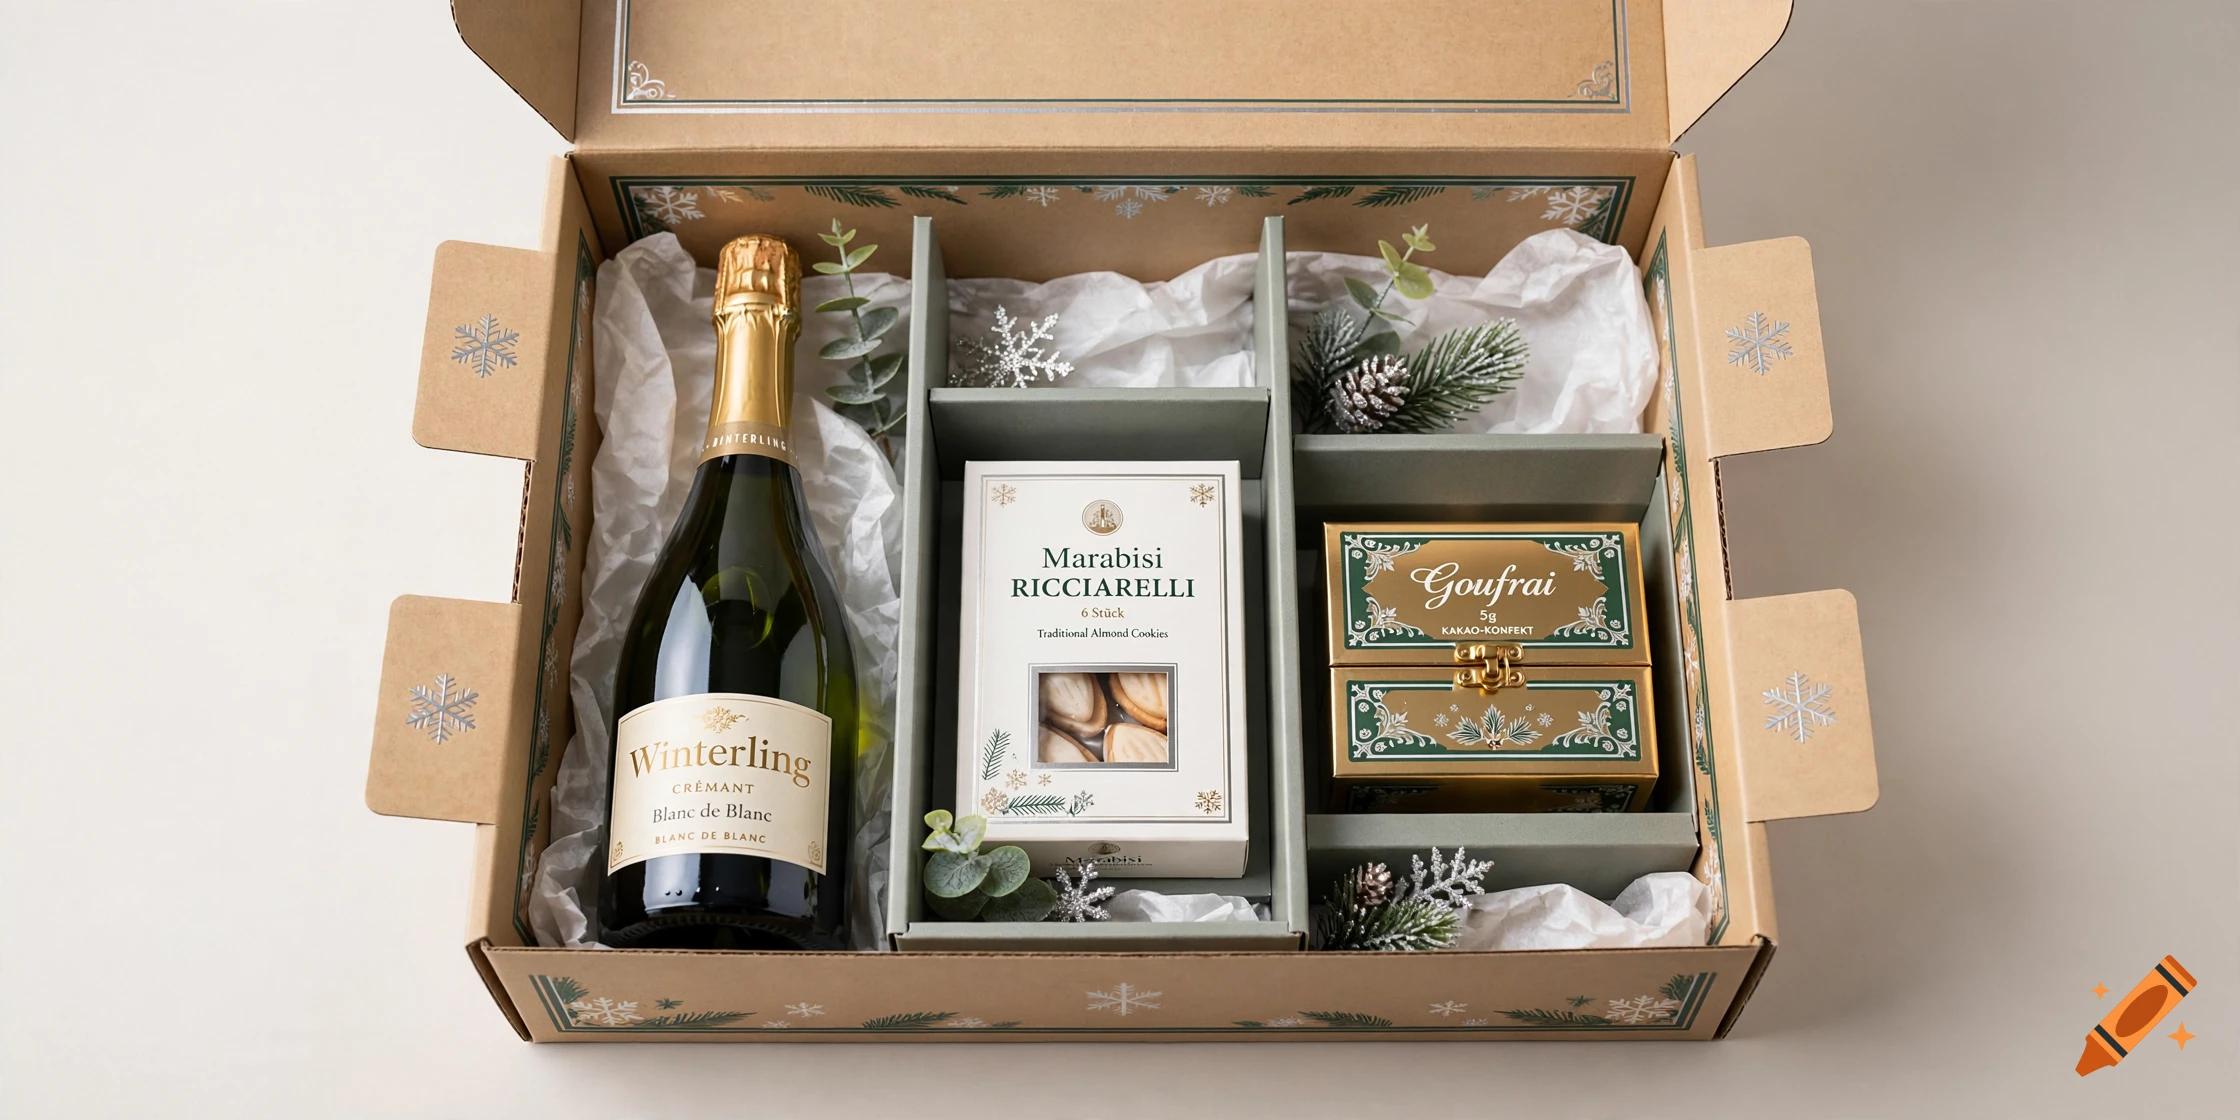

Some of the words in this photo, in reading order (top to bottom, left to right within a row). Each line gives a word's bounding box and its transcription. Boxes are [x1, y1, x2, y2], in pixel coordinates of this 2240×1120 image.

[1042, 547, 1164, 569] Marabisi
[1010, 577, 1196, 598] RICCIARELLI
[1409, 561, 1557, 610] Goufrai
[1081, 607, 1089, 618] 6
[1091, 606, 1125, 618] Stück
[1479, 609, 1497, 624] 5g
[1036, 627, 1088, 639] Traditional
[1090, 627, 1129, 639] Almond
[1131, 627, 1169, 639] Cookies
[1441, 625, 1534, 636] KAKAO-KONFEKT
[629, 735, 812, 788] Winterling
[672, 779, 755, 795] CRÉMANT
[652, 806, 695, 824] Blanc
[700, 802, 721, 818] de
[725, 803, 773, 823] Blanc
[655, 831, 695, 845] BLANC
[701, 831, 717, 840] DE
[723, 831, 767, 844] BLANC
